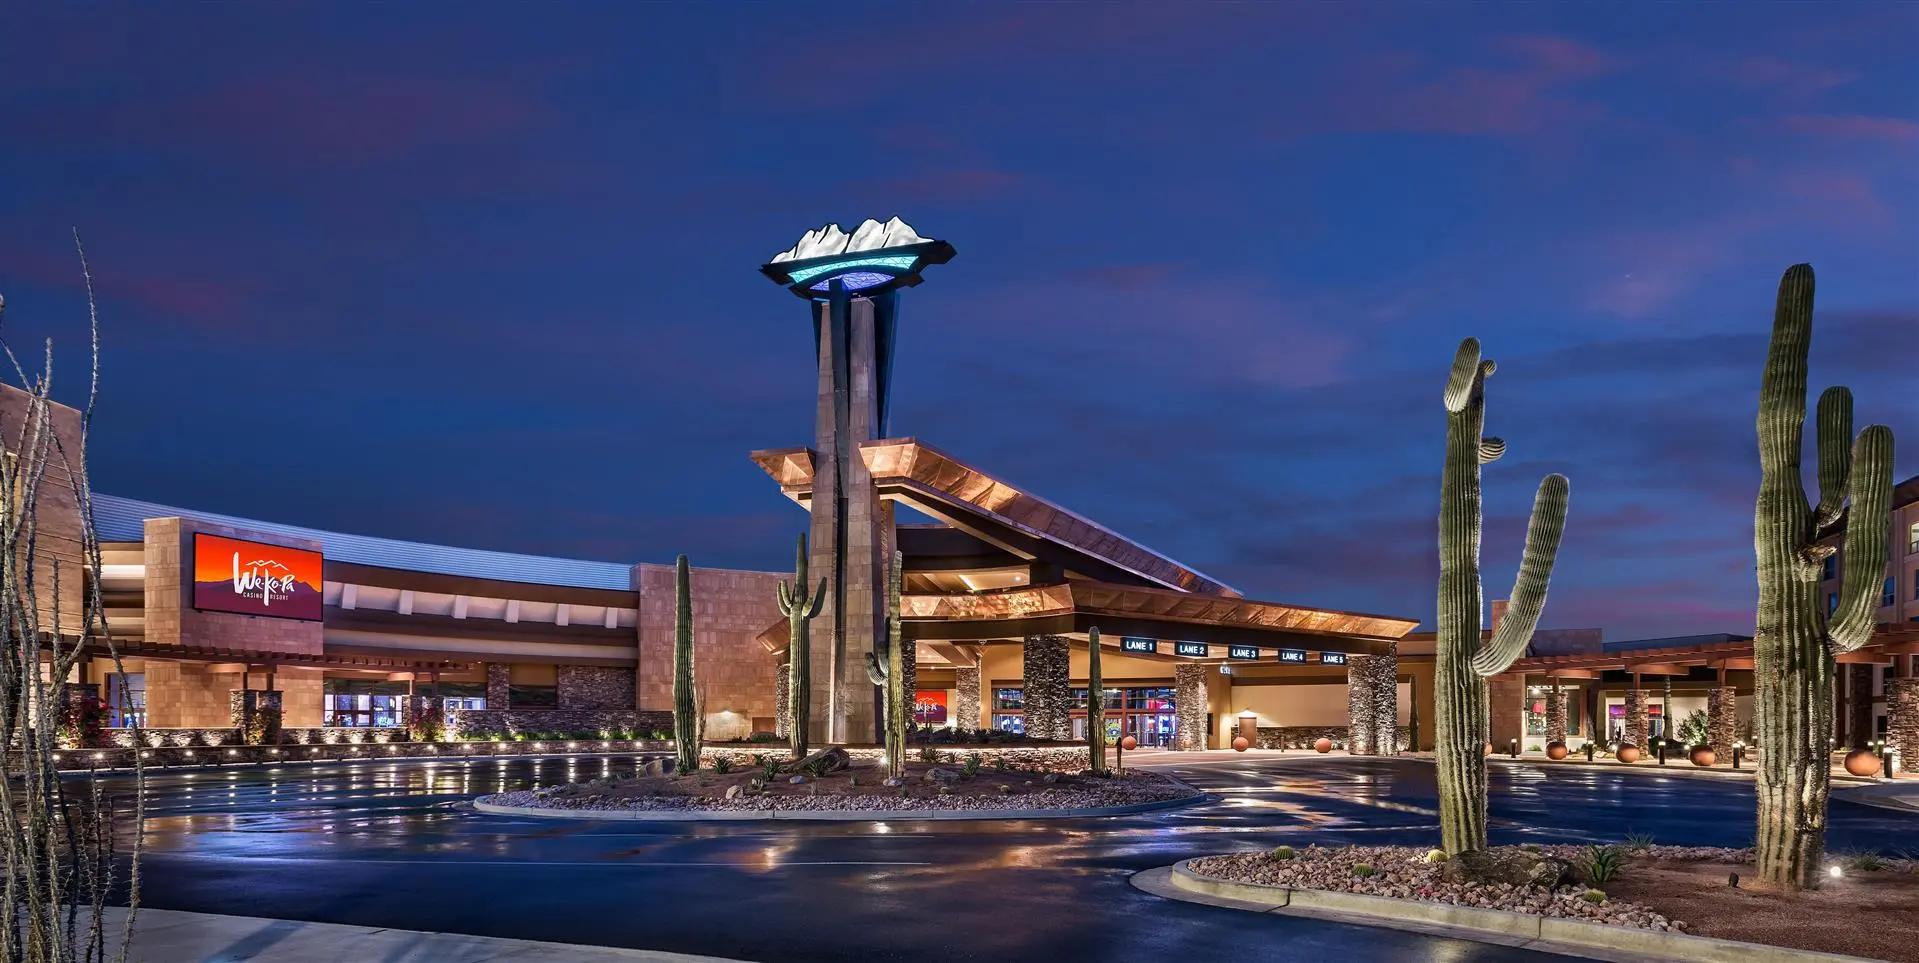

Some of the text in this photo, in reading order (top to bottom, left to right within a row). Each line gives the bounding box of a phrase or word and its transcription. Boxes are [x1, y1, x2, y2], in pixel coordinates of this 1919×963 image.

[1126, 641, 1147, 650] LANE
[1180, 645, 1205, 655] LANE 2
[1233, 649, 1256, 658] LANE 3
[1324, 655, 1339, 663] LANE
